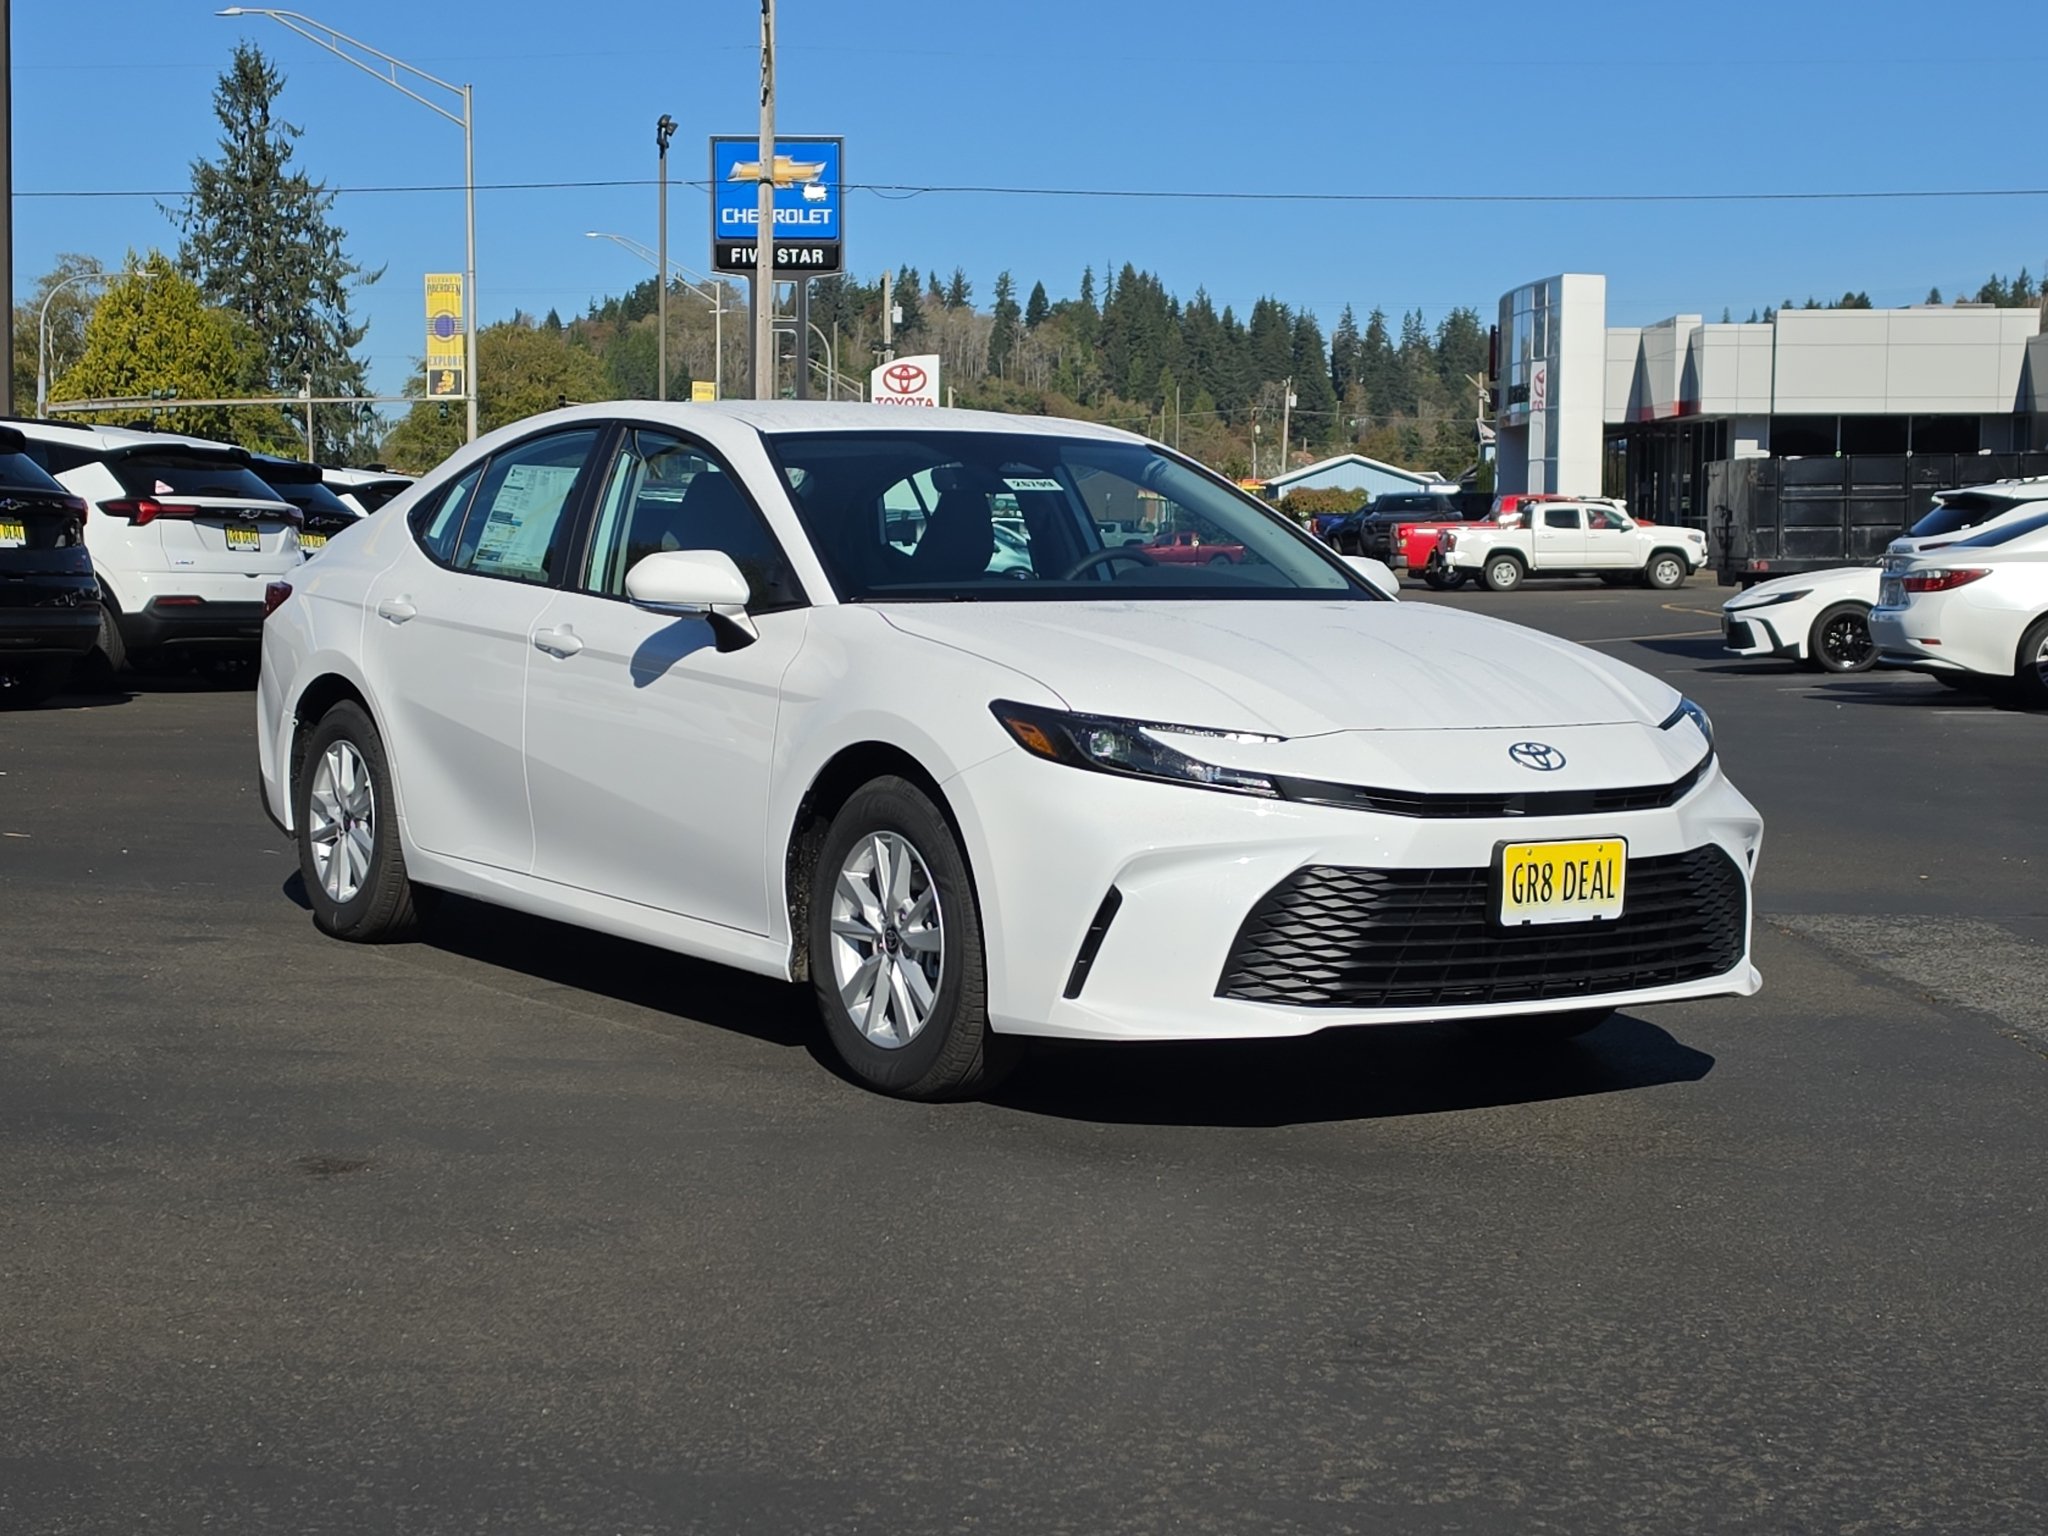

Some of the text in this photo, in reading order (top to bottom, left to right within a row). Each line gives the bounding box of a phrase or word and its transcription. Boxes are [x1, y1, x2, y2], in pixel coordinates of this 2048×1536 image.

[722, 208, 832, 224] CHEROLET
[731, 248, 824, 263] FIV STAR
[875, 397, 934, 407] TOYOTA
[1512, 860, 1615, 904] GR8 DEAL
